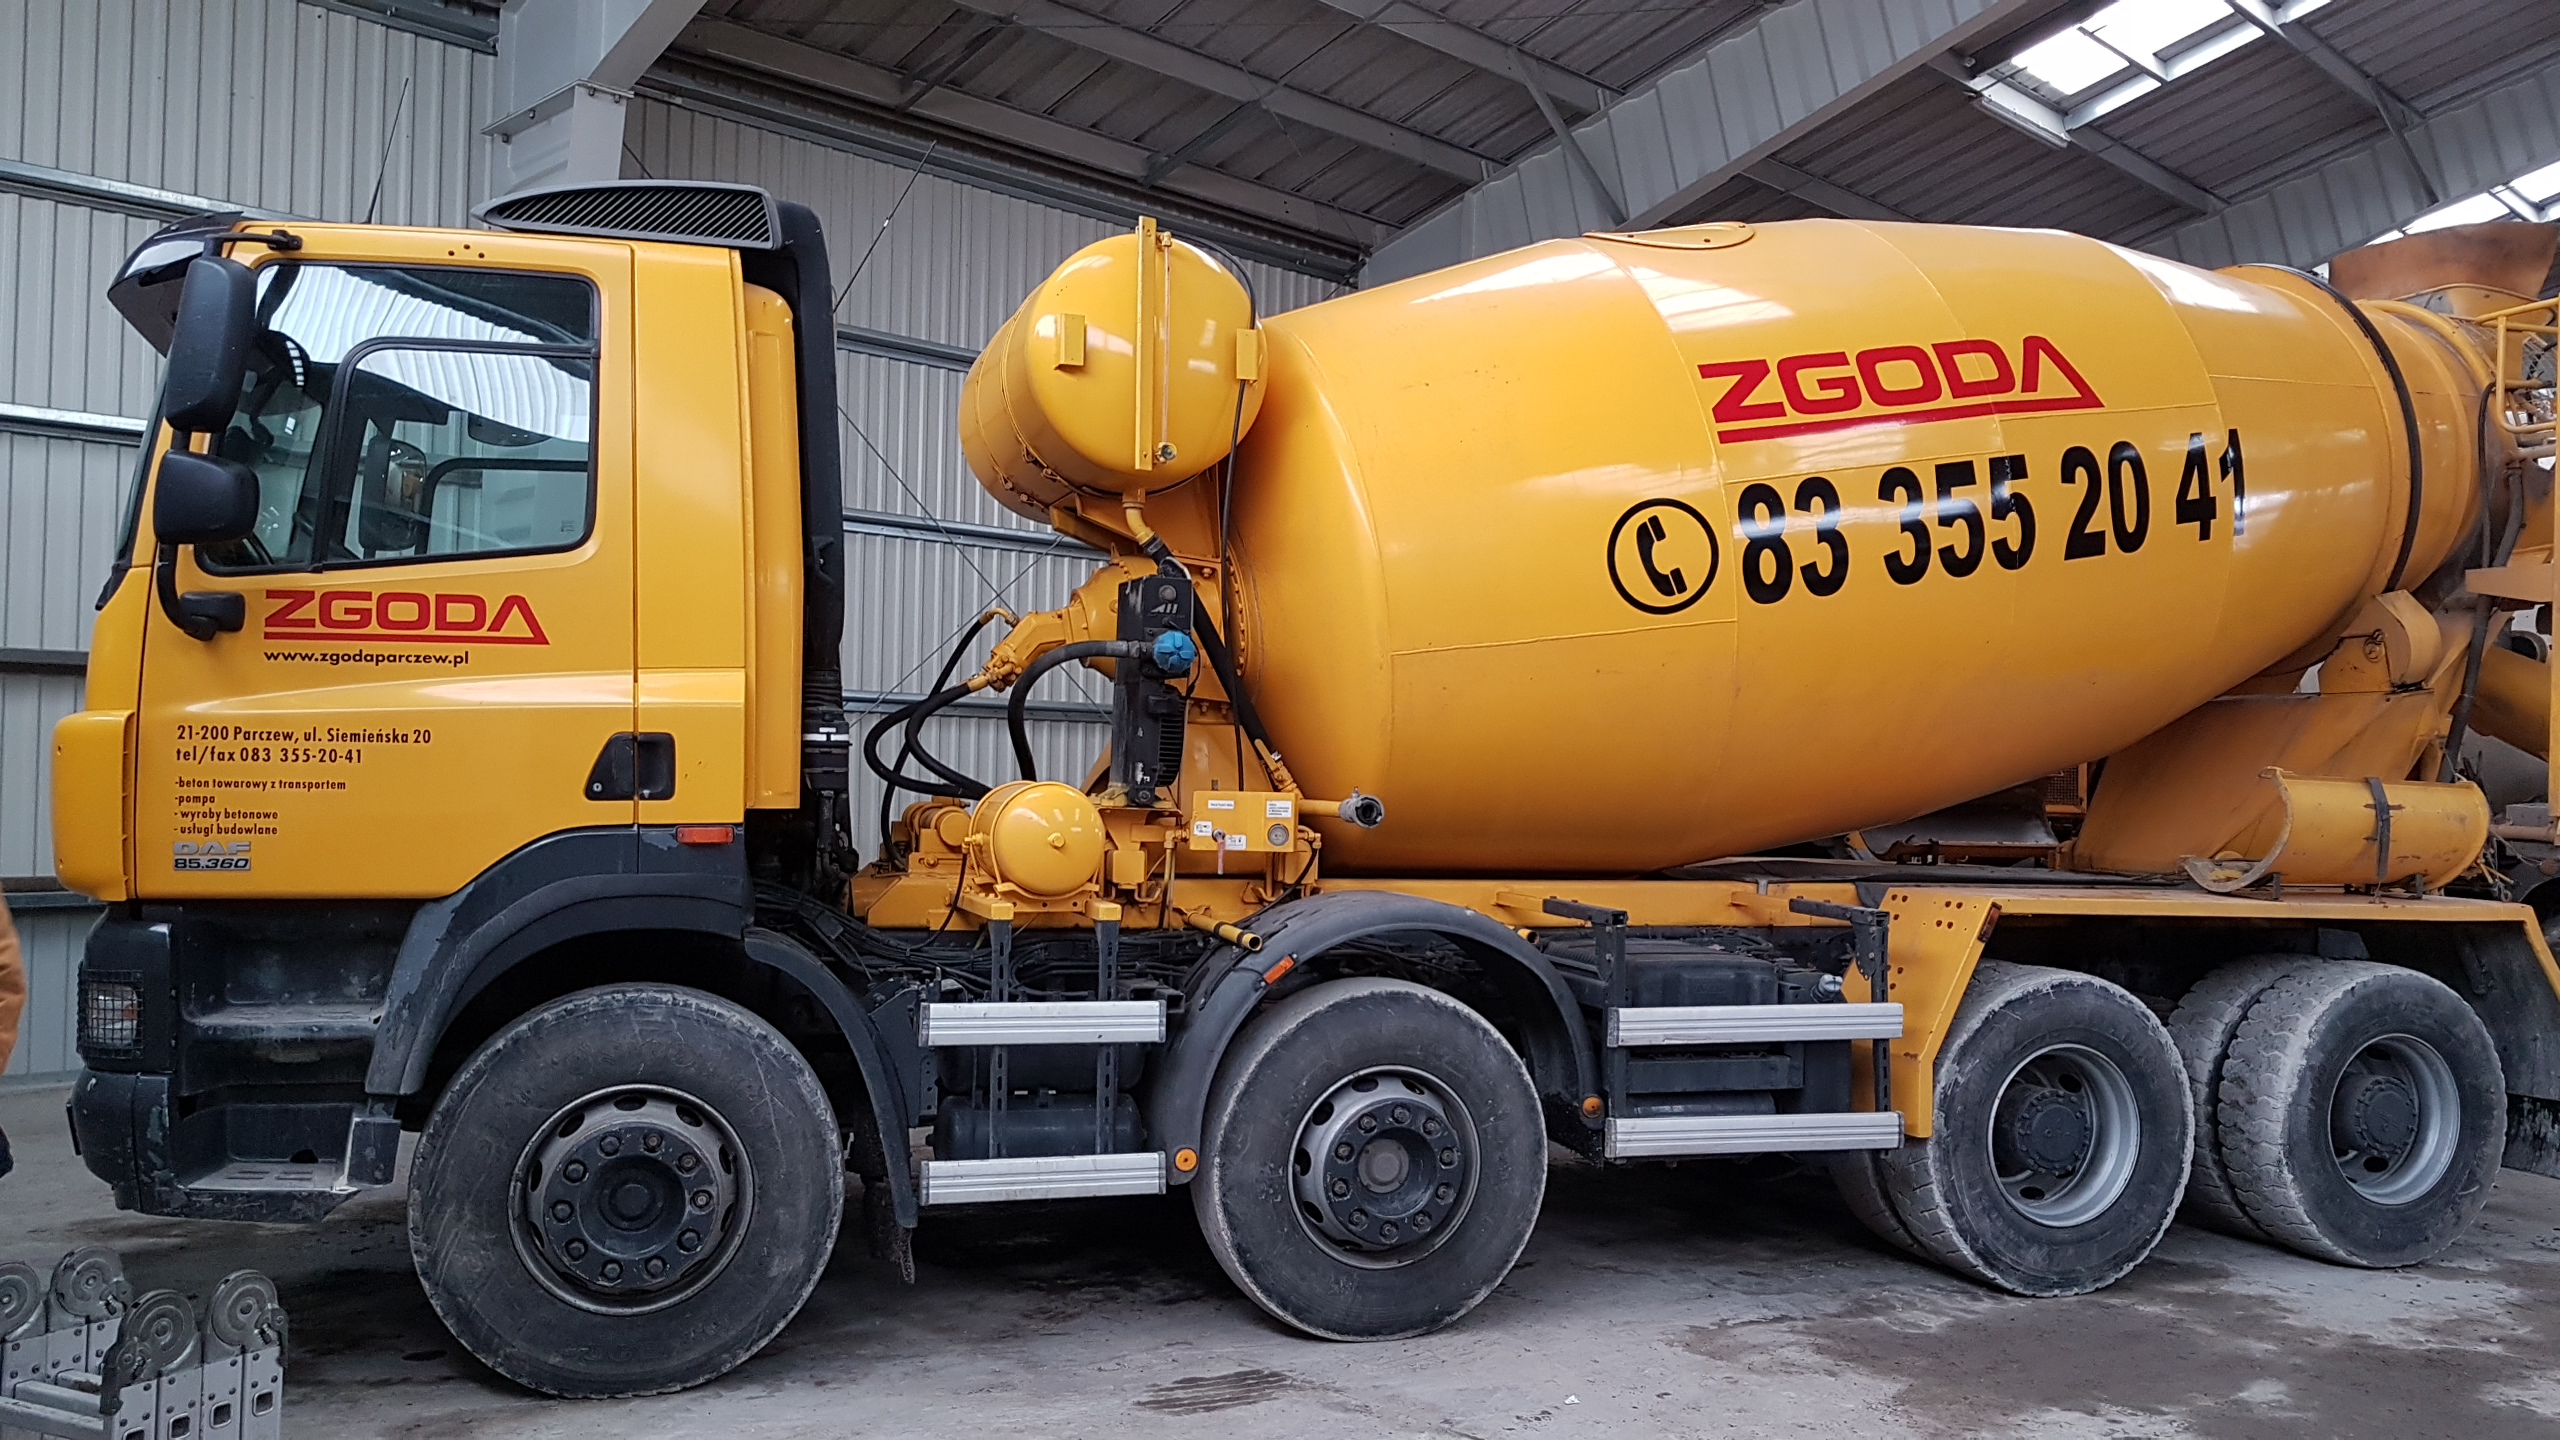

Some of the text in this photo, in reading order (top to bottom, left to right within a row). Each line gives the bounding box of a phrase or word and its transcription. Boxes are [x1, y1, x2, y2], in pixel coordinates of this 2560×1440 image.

[1697, 336, 2105, 423] ZGODA
[1737, 428, 2245, 604] 83 355 20 41
[264, 589, 550, 645] ZGODA
[264, 650, 469, 667] www.zgodaparczew.pl
[177, 725, 431, 744] 21-200 Parczew, ul. Siemieńska 20
[176, 746, 362, 764] tel/fax 083 355-20-41
[212, 779, 268, 791] towarowy
[279, 780, 346, 792] transportem
[180, 808, 221, 822] wyroby
[224, 808, 278, 819] betonowe
[180, 823, 214, 837] usługi
[217, 823, 278, 835] budowlane
[173, 841, 251, 855] DAF
[174, 858, 249, 869] 85.360
